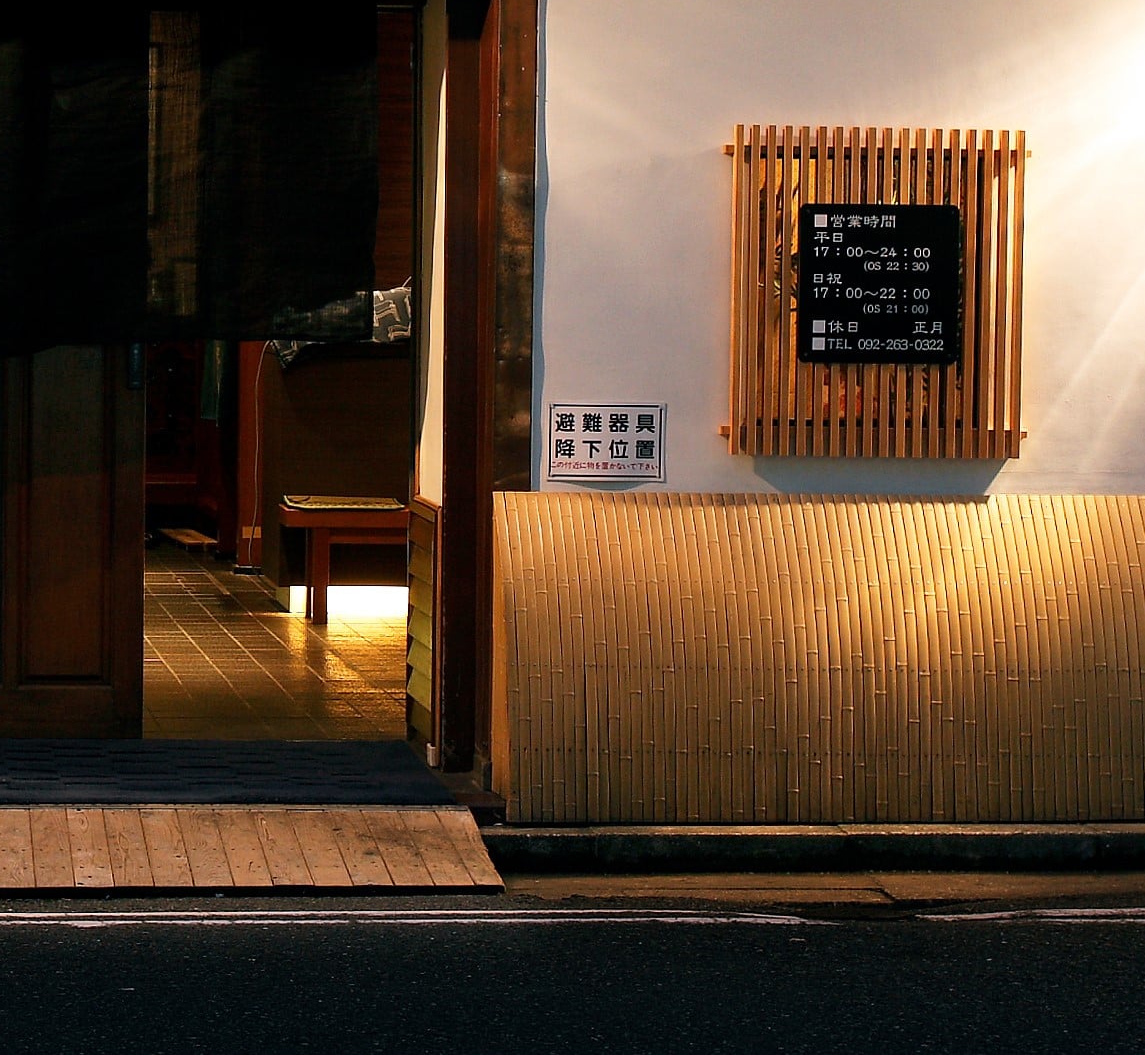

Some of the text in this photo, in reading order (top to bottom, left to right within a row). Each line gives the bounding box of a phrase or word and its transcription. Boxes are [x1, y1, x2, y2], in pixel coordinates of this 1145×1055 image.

[830, 214, 897, 229] 営業時間
[813, 231, 844, 244] 平日
[813, 272, 843, 285] 日祝
[827, 319, 943, 335] 休日 正月
[827, 338, 945, 352] TEL 092-263-0322
[555, 412, 656, 434] 避難器具
[554, 438, 656, 460] 降下位置
